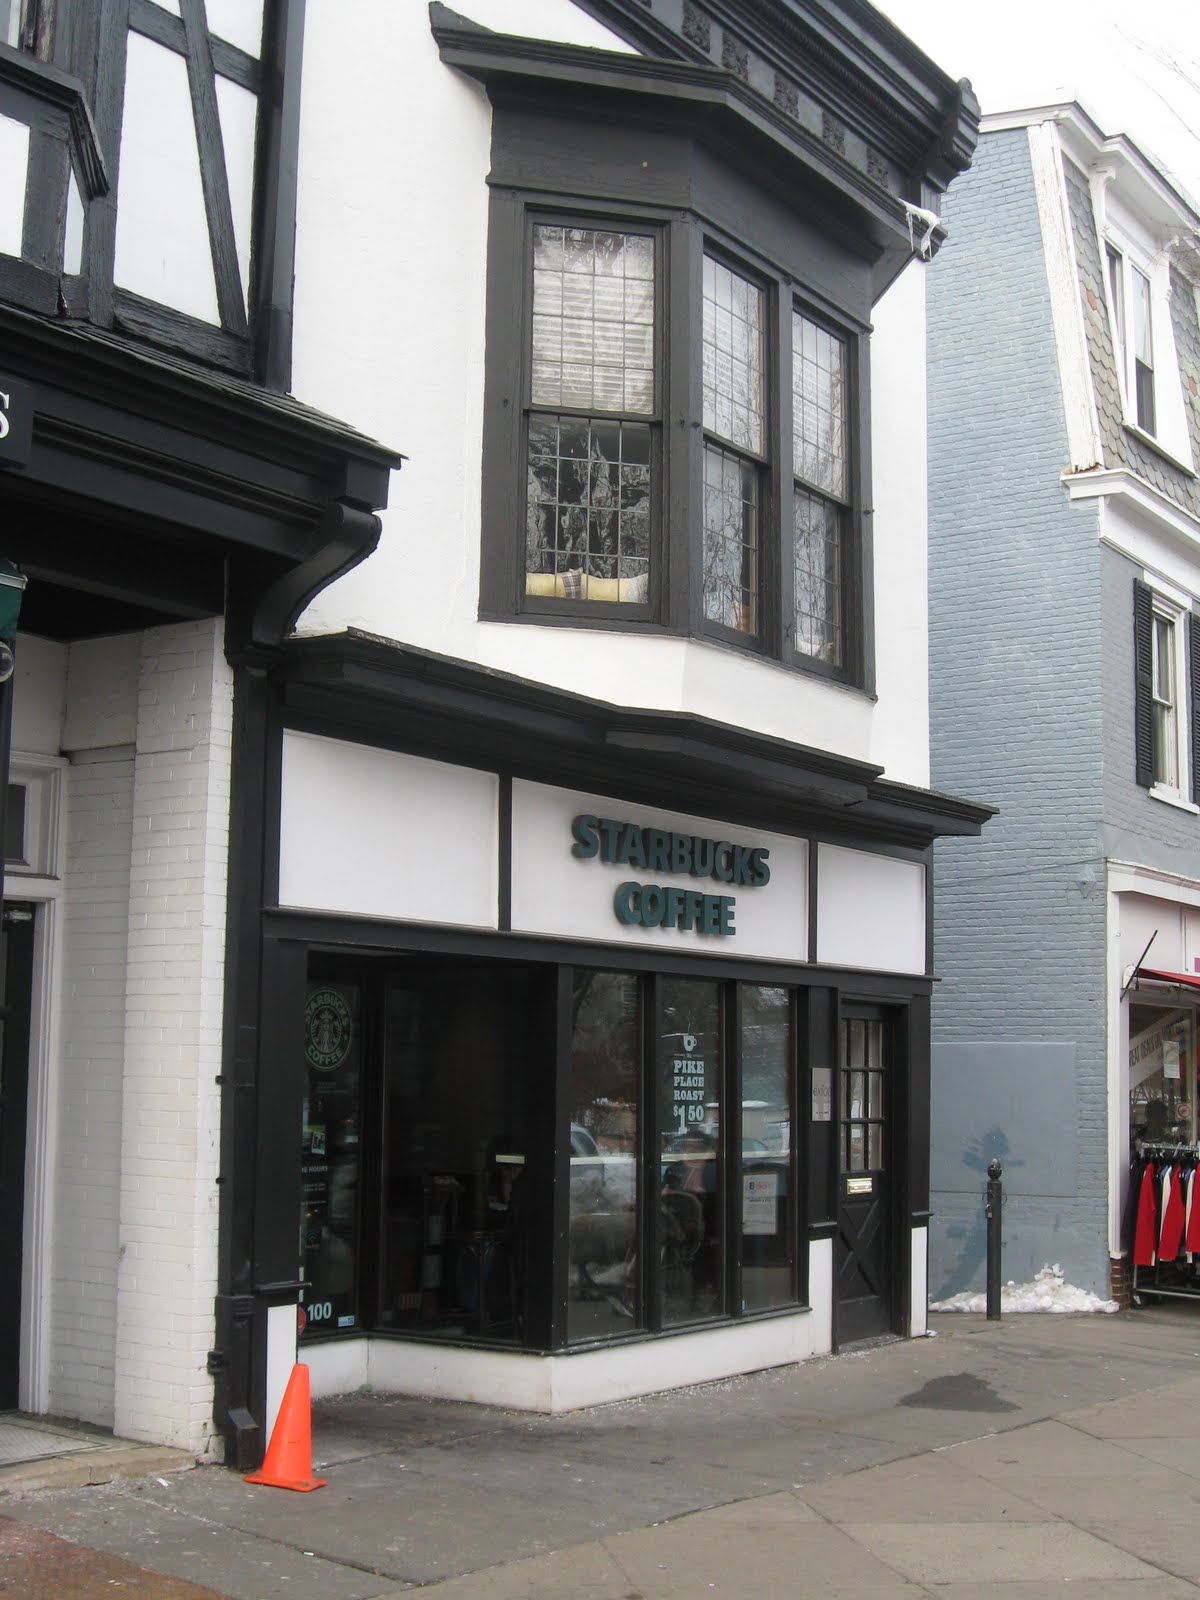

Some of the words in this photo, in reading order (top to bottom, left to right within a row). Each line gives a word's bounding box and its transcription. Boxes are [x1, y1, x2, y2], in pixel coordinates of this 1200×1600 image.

[571, 814, 771, 887] STARBUCKS
[614, 881, 736, 936] COFFEE
[307, 1044, 343, 1065] COFFEE
[673, 1060, 705, 1074] PIKE
[673, 1076, 705, 1087] PLACE
[673, 1090, 705, 1101] ROAST
[307, 1302, 332, 1322] 100
